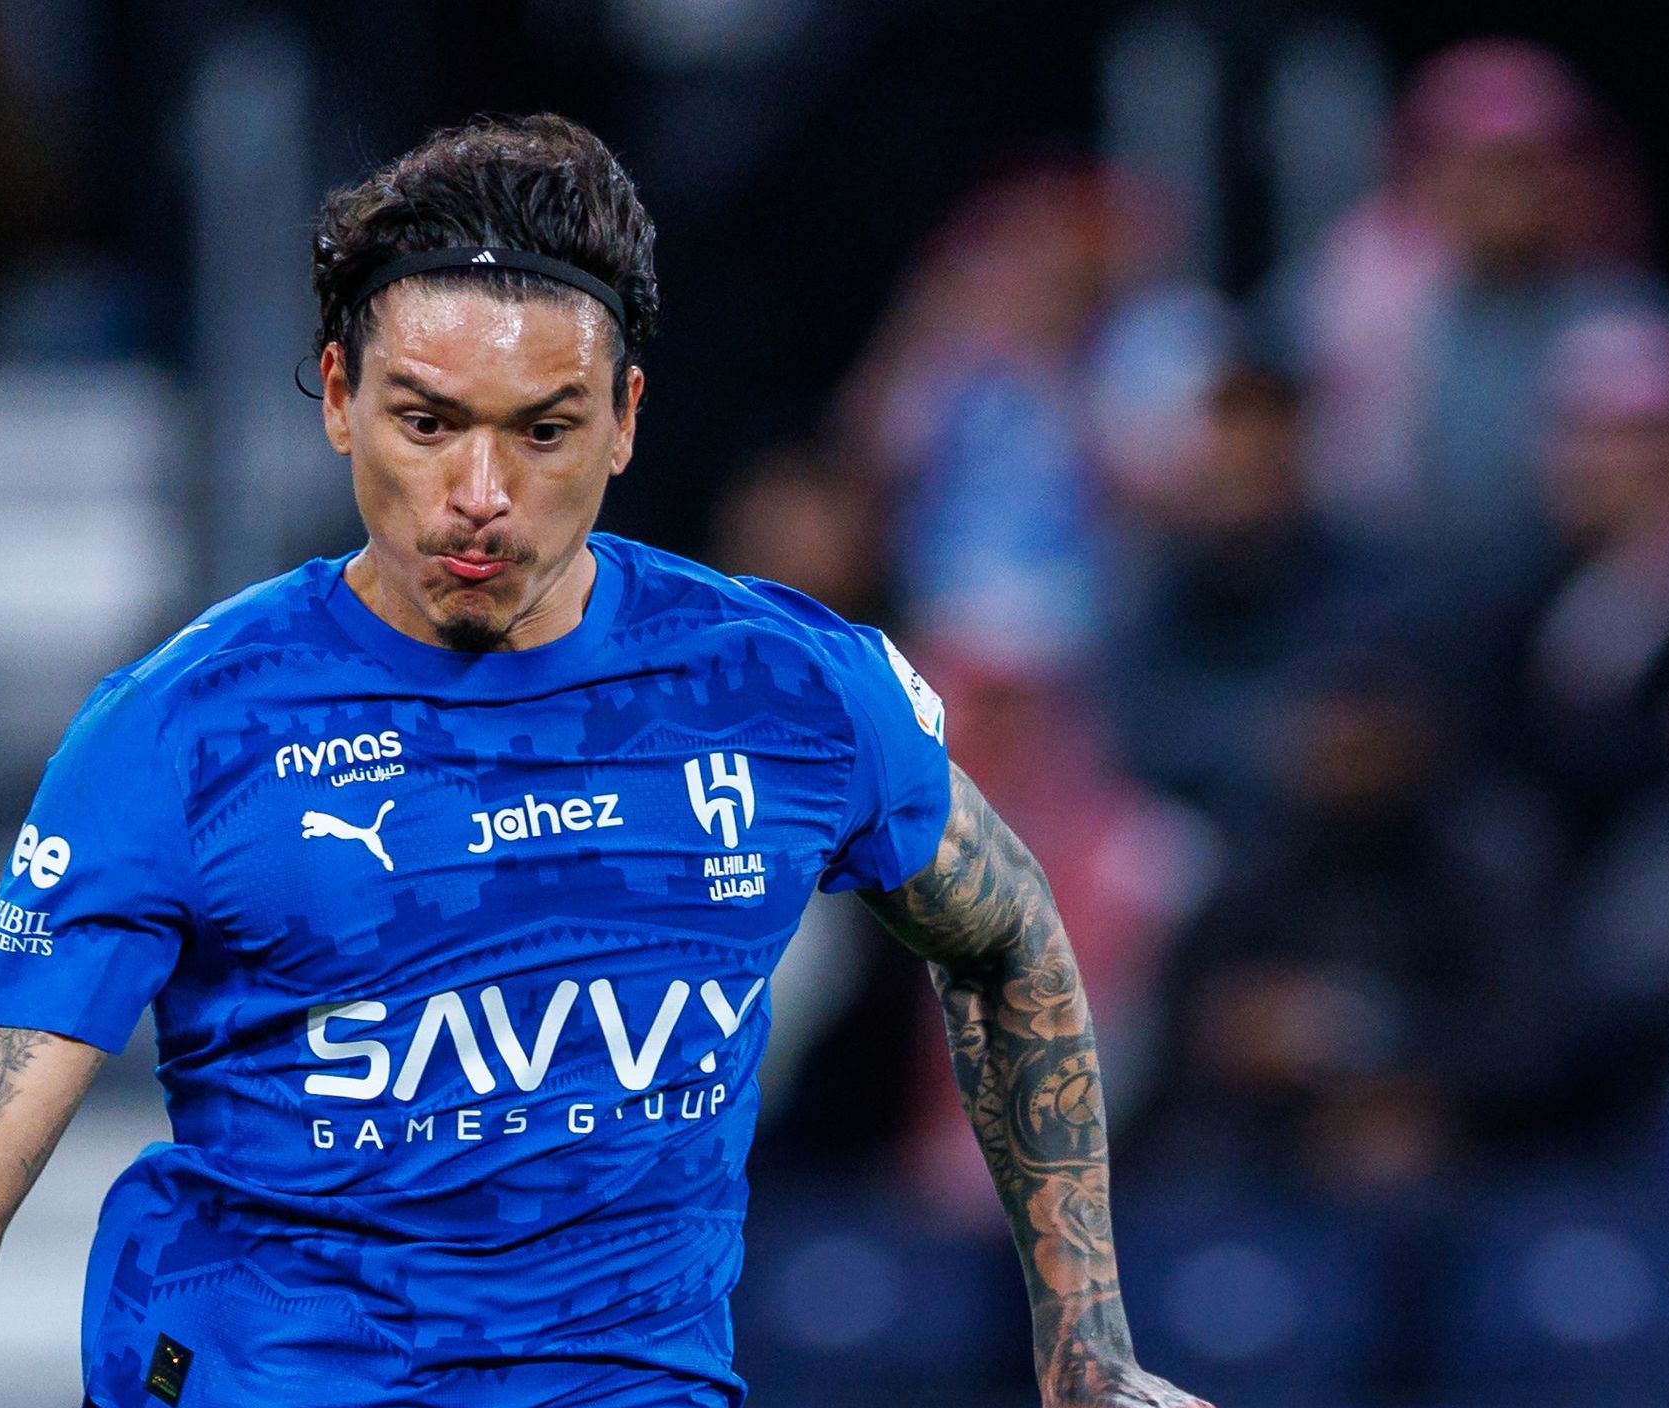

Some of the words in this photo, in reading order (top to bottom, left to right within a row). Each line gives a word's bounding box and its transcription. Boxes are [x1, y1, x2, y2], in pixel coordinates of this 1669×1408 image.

[275, 730, 403, 778] flynas
[366, 762, 406, 783] طيران
[330, 766, 366, 788] ناس
[709, 875, 766, 901] الهلال
[304, 977, 766, 1101] SAVVY
[312, 1108, 527, 1150] GAMES
[568, 1083, 726, 1134] GOUP
